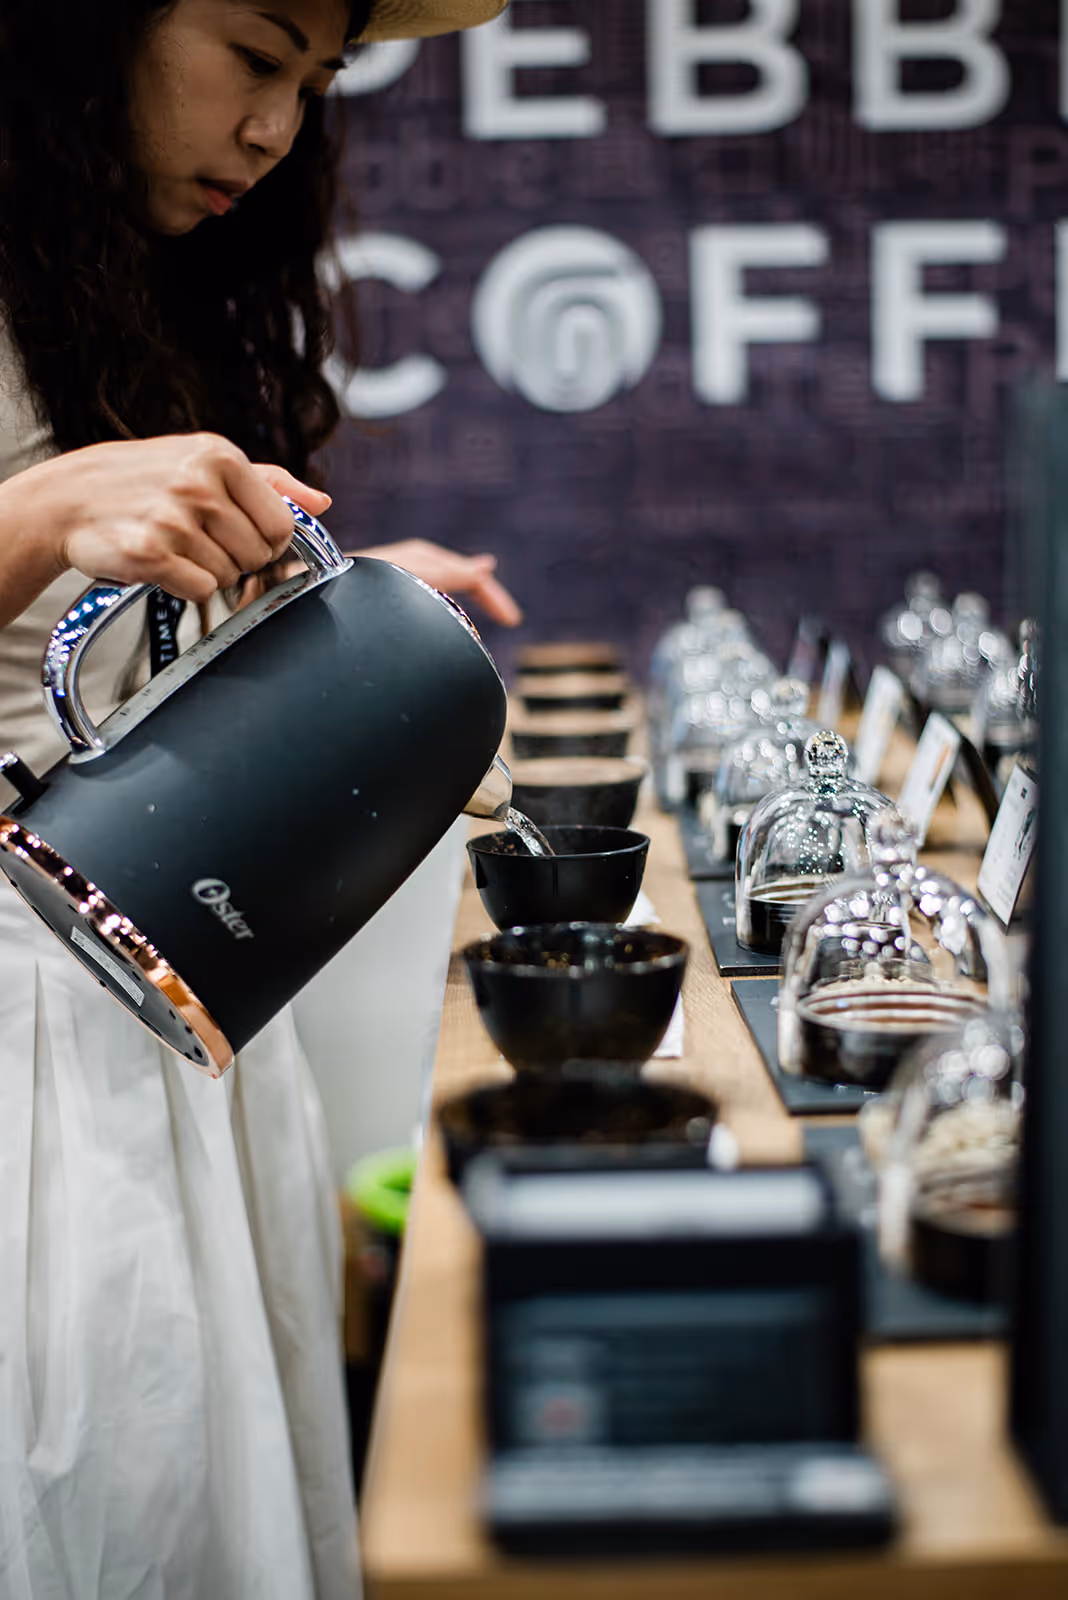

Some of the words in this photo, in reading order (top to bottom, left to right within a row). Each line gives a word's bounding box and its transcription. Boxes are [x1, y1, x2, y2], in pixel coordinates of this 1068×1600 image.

[325, 0, 1068, 139] EBB
[314, 221, 1068, 418] COFF
[192, 878, 255, 939] Oster
